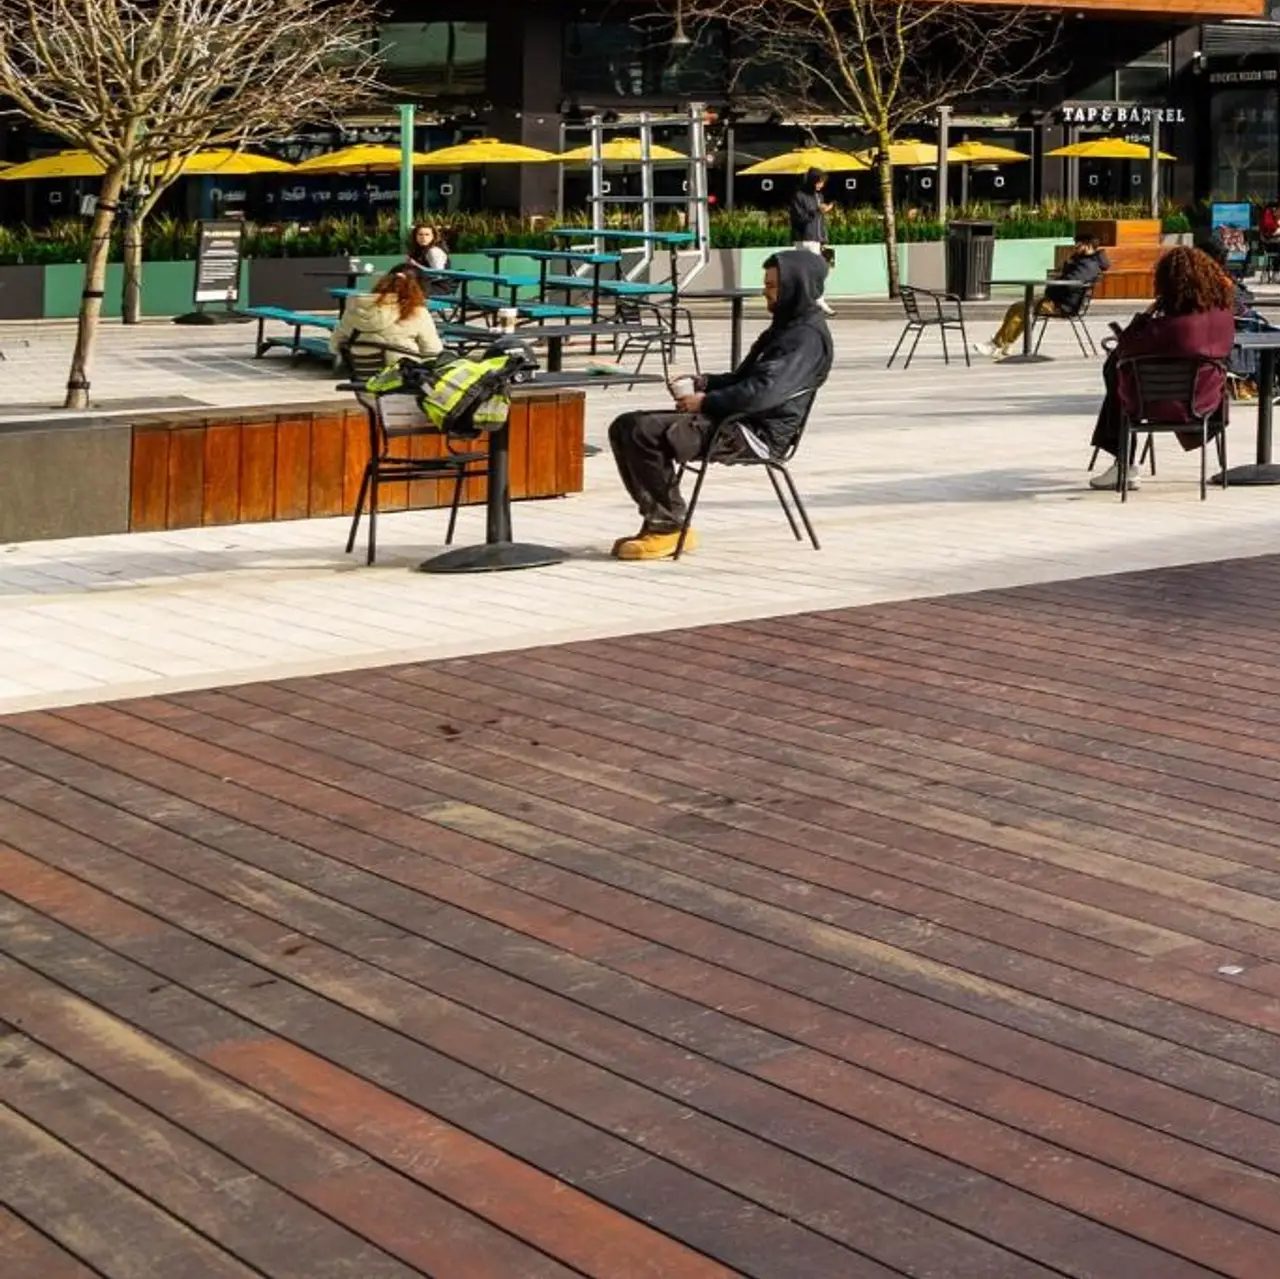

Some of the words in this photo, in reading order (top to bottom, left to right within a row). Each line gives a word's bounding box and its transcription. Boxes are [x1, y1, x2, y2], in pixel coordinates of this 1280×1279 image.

[1062, 106, 1098, 122] TAP
[1101, 105, 1113, 122] &
[1117, 107, 1185, 122] BARREL
